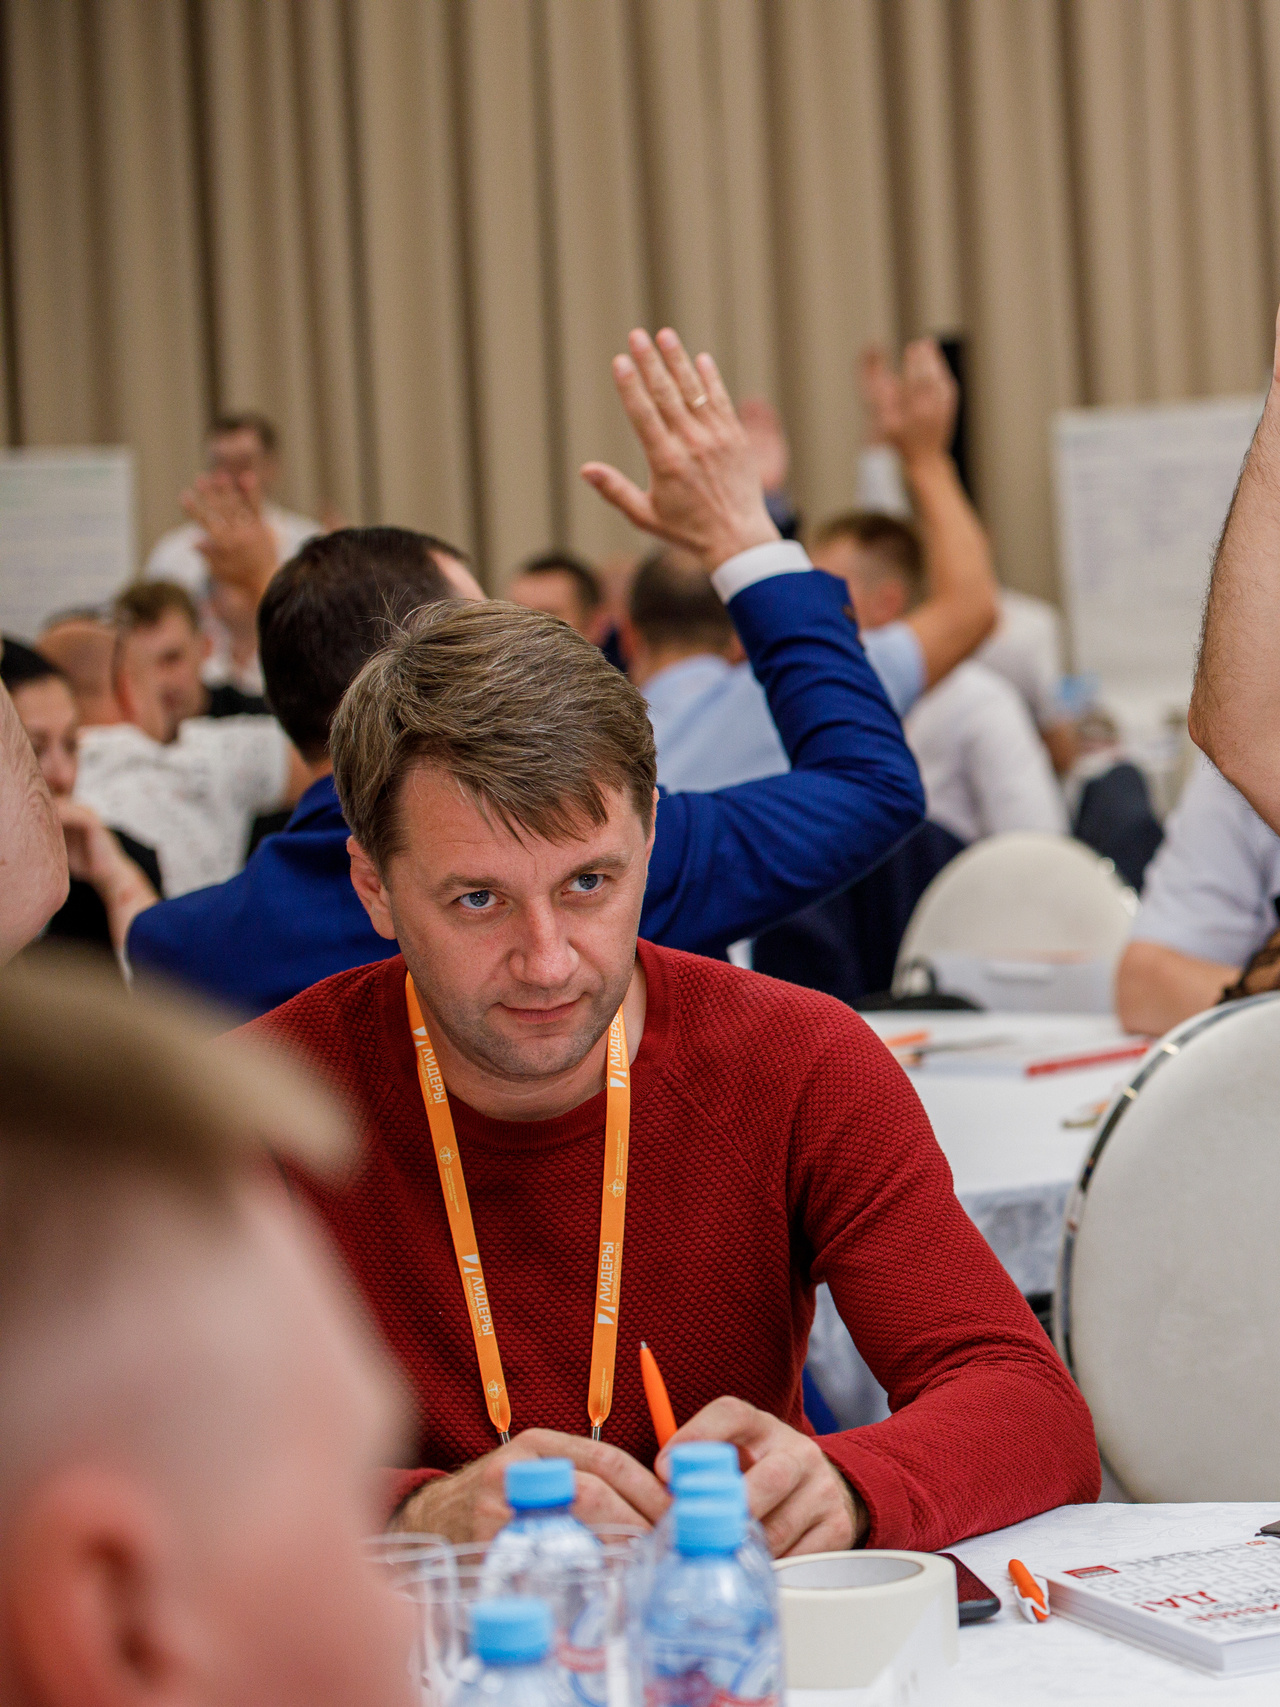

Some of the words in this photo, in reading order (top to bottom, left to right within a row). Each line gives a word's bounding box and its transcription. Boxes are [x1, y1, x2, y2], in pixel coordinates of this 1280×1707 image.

[422, 1048, 447, 1104] ЛИДЕРЫ
[599, 1241, 614, 1303] ЛИДЕРЫ
[471, 1277, 494, 1336] ЛИДЕРЫ
[1132, 1590, 1219, 1613] ДА!
